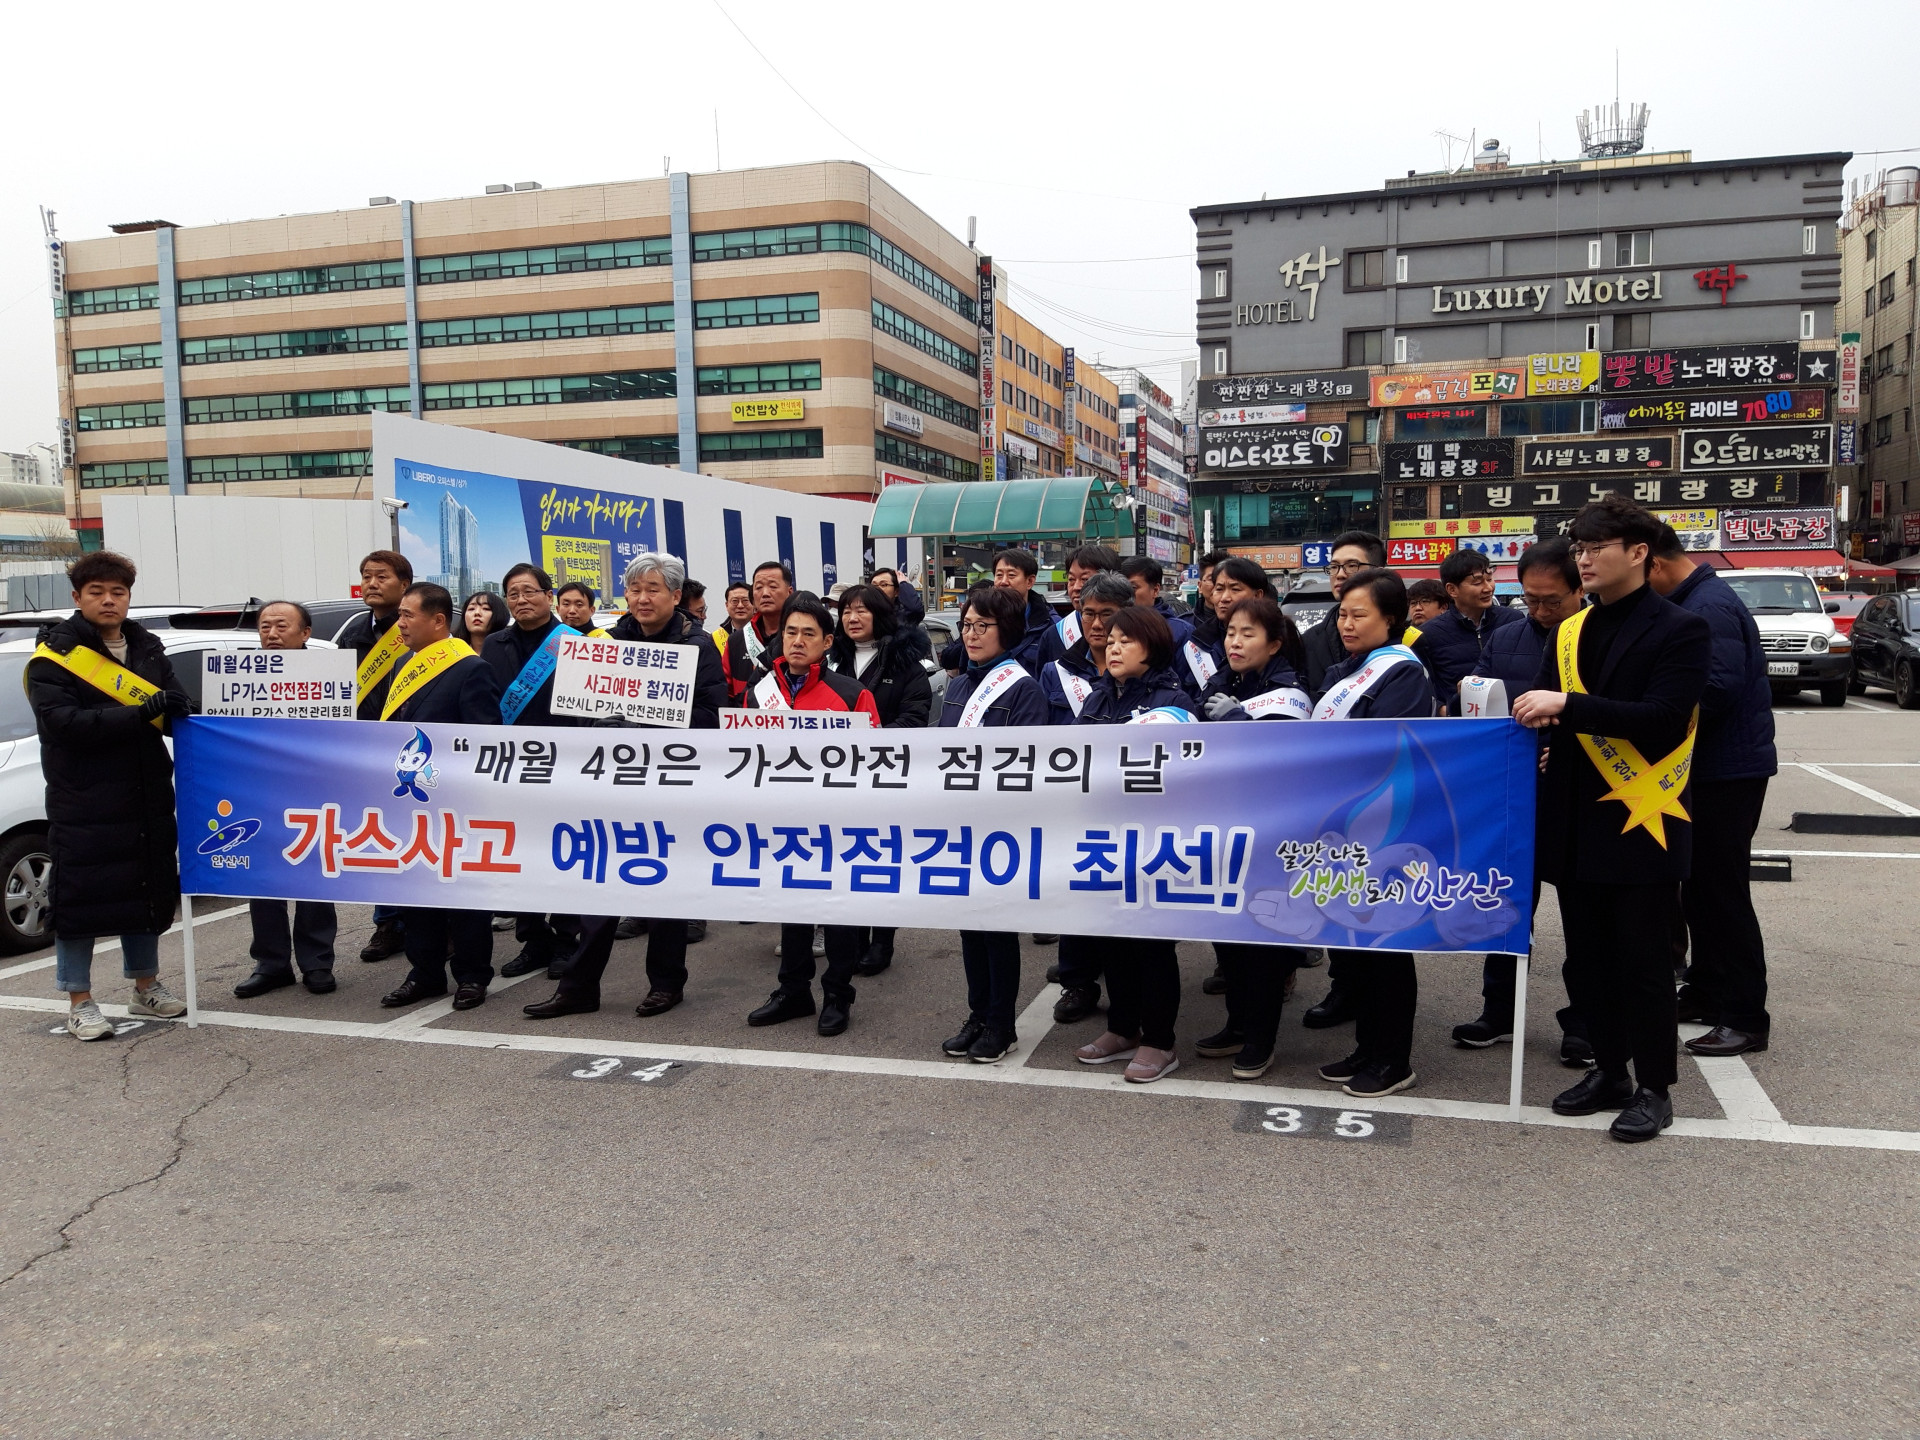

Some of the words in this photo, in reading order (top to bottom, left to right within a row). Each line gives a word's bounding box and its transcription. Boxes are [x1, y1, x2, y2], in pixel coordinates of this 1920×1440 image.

[982, 279, 992, 325] 노래광장
[1432, 285, 1551, 314] Luxury
[1565, 272, 1663, 305] Motel
[1237, 298, 1303, 325] HOTEL
[1533, 355, 1581, 375] 별나라
[1681, 355, 1778, 379] 노래광장
[1219, 382, 1270, 402] 짠짠짠
[1274, 379, 1335, 398] 노래광장
[1336, 385, 1352, 396] 3F
[1432, 378, 1469, 400] 곱창
[1473, 374, 1517, 394] 포차
[1535, 378, 1582, 393] 노래광장
[1588, 384, 1598, 392] B1
[734, 404, 778, 417] 이천밥상
[1690, 400, 1738, 418] 라이브
[1742, 391, 1792, 422] 7080
[1807, 408, 1822, 418] 3F
[1206, 432, 1232, 443] 특별한
[1233, 431, 1262, 443] 당신을
[1262, 429, 1281, 442] 위한
[1282, 429, 1311, 441] 사진관
[1812, 430, 1827, 439] 2F
[1205, 442, 1313, 468] 미스터포토
[1417, 443, 1460, 460] 대박
[1532, 448, 1574, 467] 샤넬
[1578, 447, 1651, 464] 노래광장
[1690, 439, 1759, 465] 오드리
[1763, 444, 1821, 460] 노래광장
[412, 471, 435, 484] LIBERO
[1399, 459, 1478, 478] 노래광장
[1481, 461, 1499, 474] 3F
[1487, 484, 1561, 508] 빙고
[1588, 477, 1758, 504] 노래광장
[540, 487, 582, 532] 입지가
[1688, 511, 1706, 523] 전문
[1423, 519, 1504, 536] 원주통닭
[1725, 516, 1829, 542] 별난곱창
[555, 539, 574, 553] 중앙역
[617, 542, 631, 556] 바로
[1192, 570, 1198, 578] P
[207, 654, 284, 675] 매월4일은
[427, 649, 449, 667] 가스
[563, 641, 619, 664] 가스점검
[622, 646, 679, 670] 생활화로
[360, 649, 392, 684] 안전관리
[222, 683, 268, 702] LP가스
[271, 681, 335, 701] 안전점검의
[340, 681, 353, 700] 날
[584, 674, 642, 698] 사고예방
[646, 680, 690, 704] 철저히
[287, 705, 352, 718] 안전관리협회
[626, 705, 686, 723] 안전관리협회
[1467, 702, 1481, 717] 가
[580, 741, 702, 787] 4일은
[724, 744, 911, 788] 가스안전
[938, 743, 1093, 793] 점검의
[1658, 774, 1675, 792] 날
[211, 853, 251, 869] 안산시
[284, 804, 523, 882] 가스사고
[552, 818, 676, 886] 예방
[702, 821, 1043, 901] 안전점검이
[1069, 828, 1255, 908] 최선!
[1277, 840, 1371, 872] 살맛나는
[1410, 864, 1514, 911] 안산
[1262, 1106, 1375, 1138] 35
